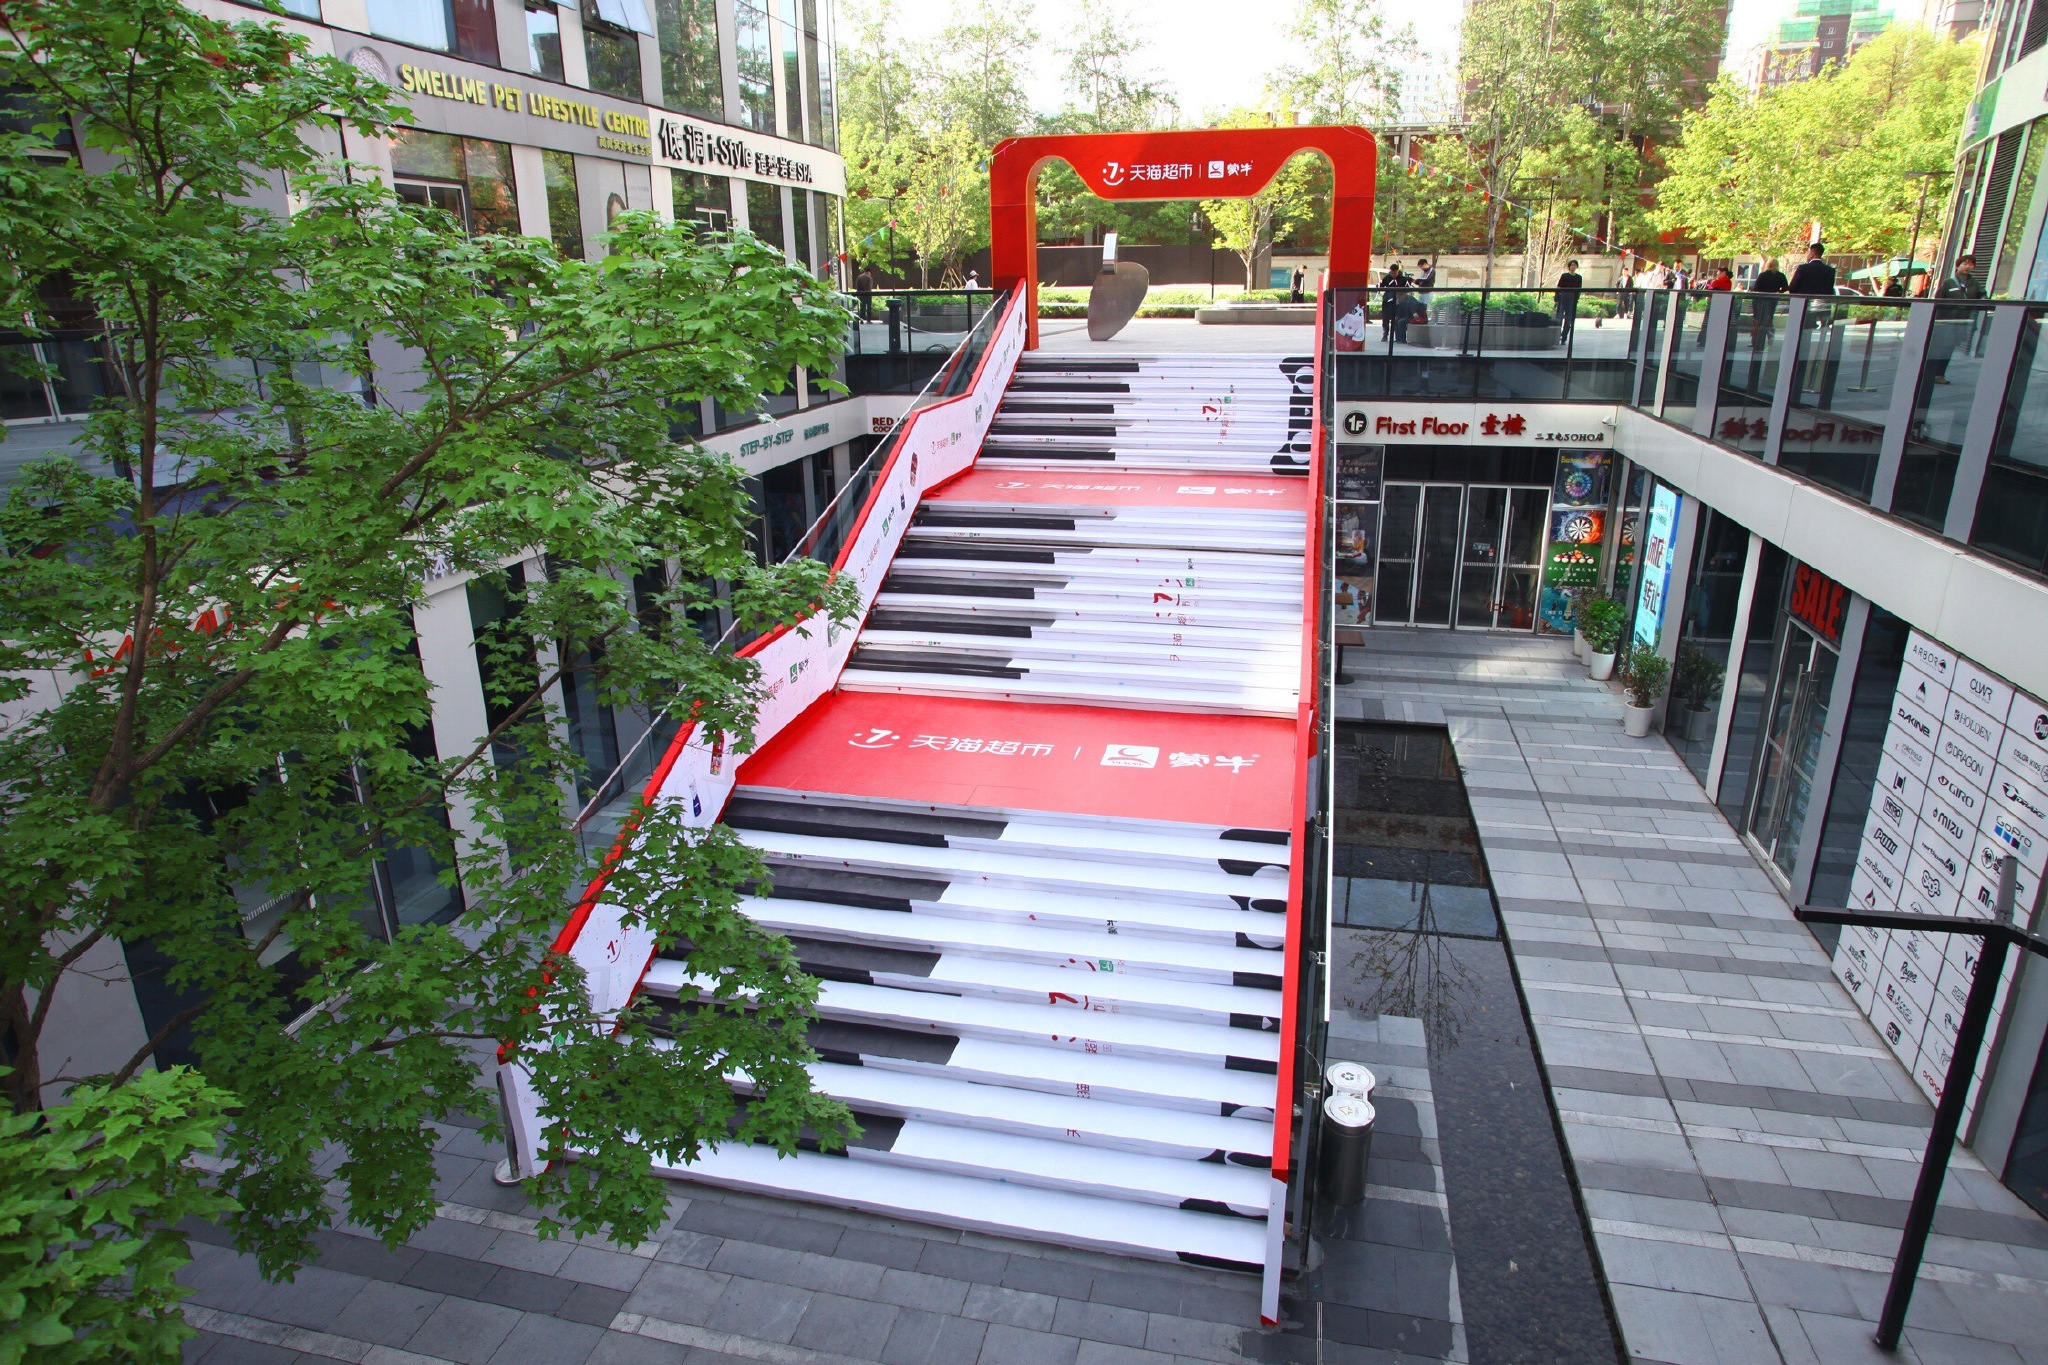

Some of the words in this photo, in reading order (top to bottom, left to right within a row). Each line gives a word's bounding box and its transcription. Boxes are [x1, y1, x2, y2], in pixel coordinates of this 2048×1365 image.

[399, 63, 487, 105] SMELLME
[492, 83, 523, 112] PET
[528, 92, 600, 128] LIFESTYLE
[603, 109, 650, 138] CENTRE
[659, 118, 706, 165] 低调
[1130, 164, 1193, 181] 天猫超市
[1227, 163, 1252, 177] 蒙牛
[872, 417, 895, 426] RED
[1375, 416, 1417, 435] First
[1421, 416, 1469, 435] Floor
[1480, 413, 1527, 436] 壹楼
[740, 429, 794, 457] STEP-BY-STEP
[1791, 563, 1845, 640] SALE
[1912, 644, 1938, 665] ARBOR
[1897, 708, 1930, 738] DAKINE
[1959, 712, 1992, 742] HOLDEN
[908, 733, 1055, 757] 天猫超市
[1168, 751, 1256, 773] 蒙牛
[1952, 744, 1985, 777] DRAGON
[2013, 748, 2029, 764] COLOR
[2029, 759, 2042, 772] KIDS
[1948, 781, 1975, 808] GIRO
[1996, 815, 2032, 848] GoPro
[1864, 856, 1884, 879] sandbox
[1923, 1070, 1944, 1098] orang
